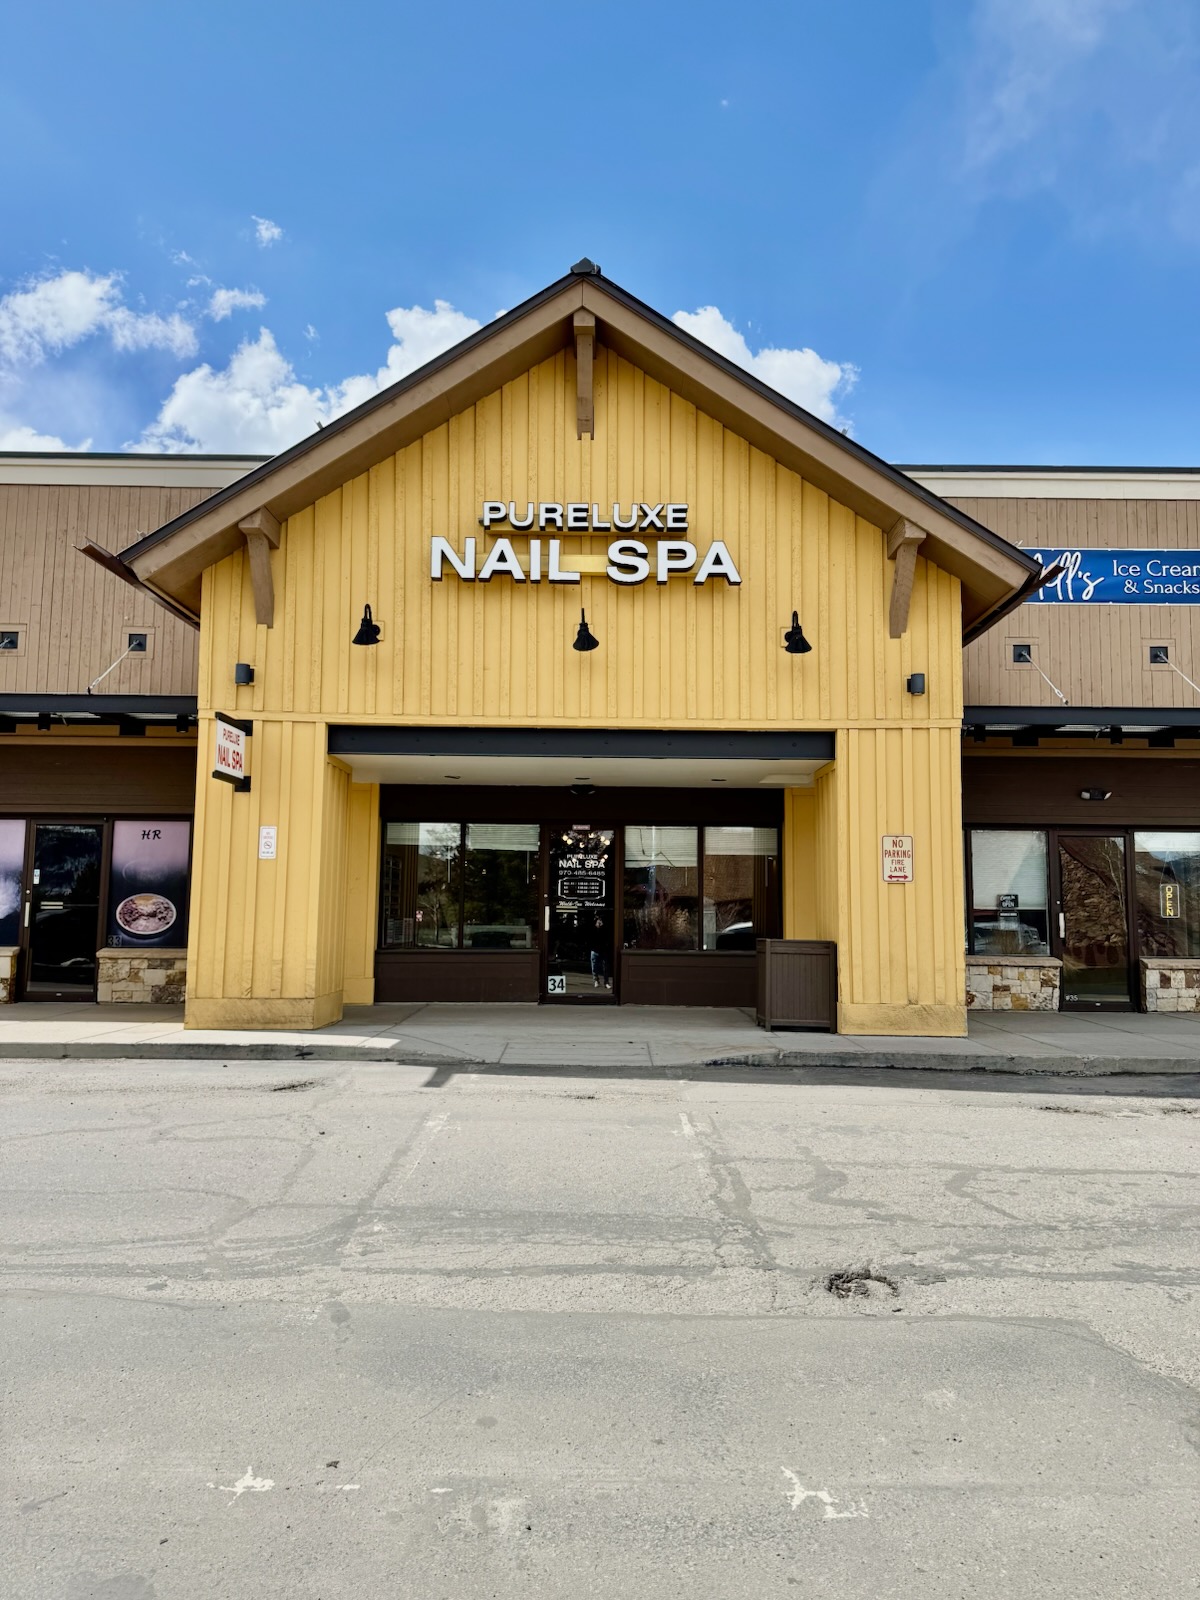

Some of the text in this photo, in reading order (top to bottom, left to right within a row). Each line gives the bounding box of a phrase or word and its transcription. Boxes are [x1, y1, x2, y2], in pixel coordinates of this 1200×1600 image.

[482, 501, 689, 532] PURELUXE
[430, 536, 742, 585] NAIL SPA
[1112, 559, 1141, 577] Ice
[1123, 579, 1200, 594] & Snacks
[217, 743, 243, 773] NAIL SPA
[141, 829, 162, 840] HR
[892, 839, 903, 848] NO
[884, 849, 911, 858] PARKING
[559, 860, 605, 868] NAIL SPA
[1165, 885, 1174, 916] OPEN
[549, 978, 564, 991] 34
